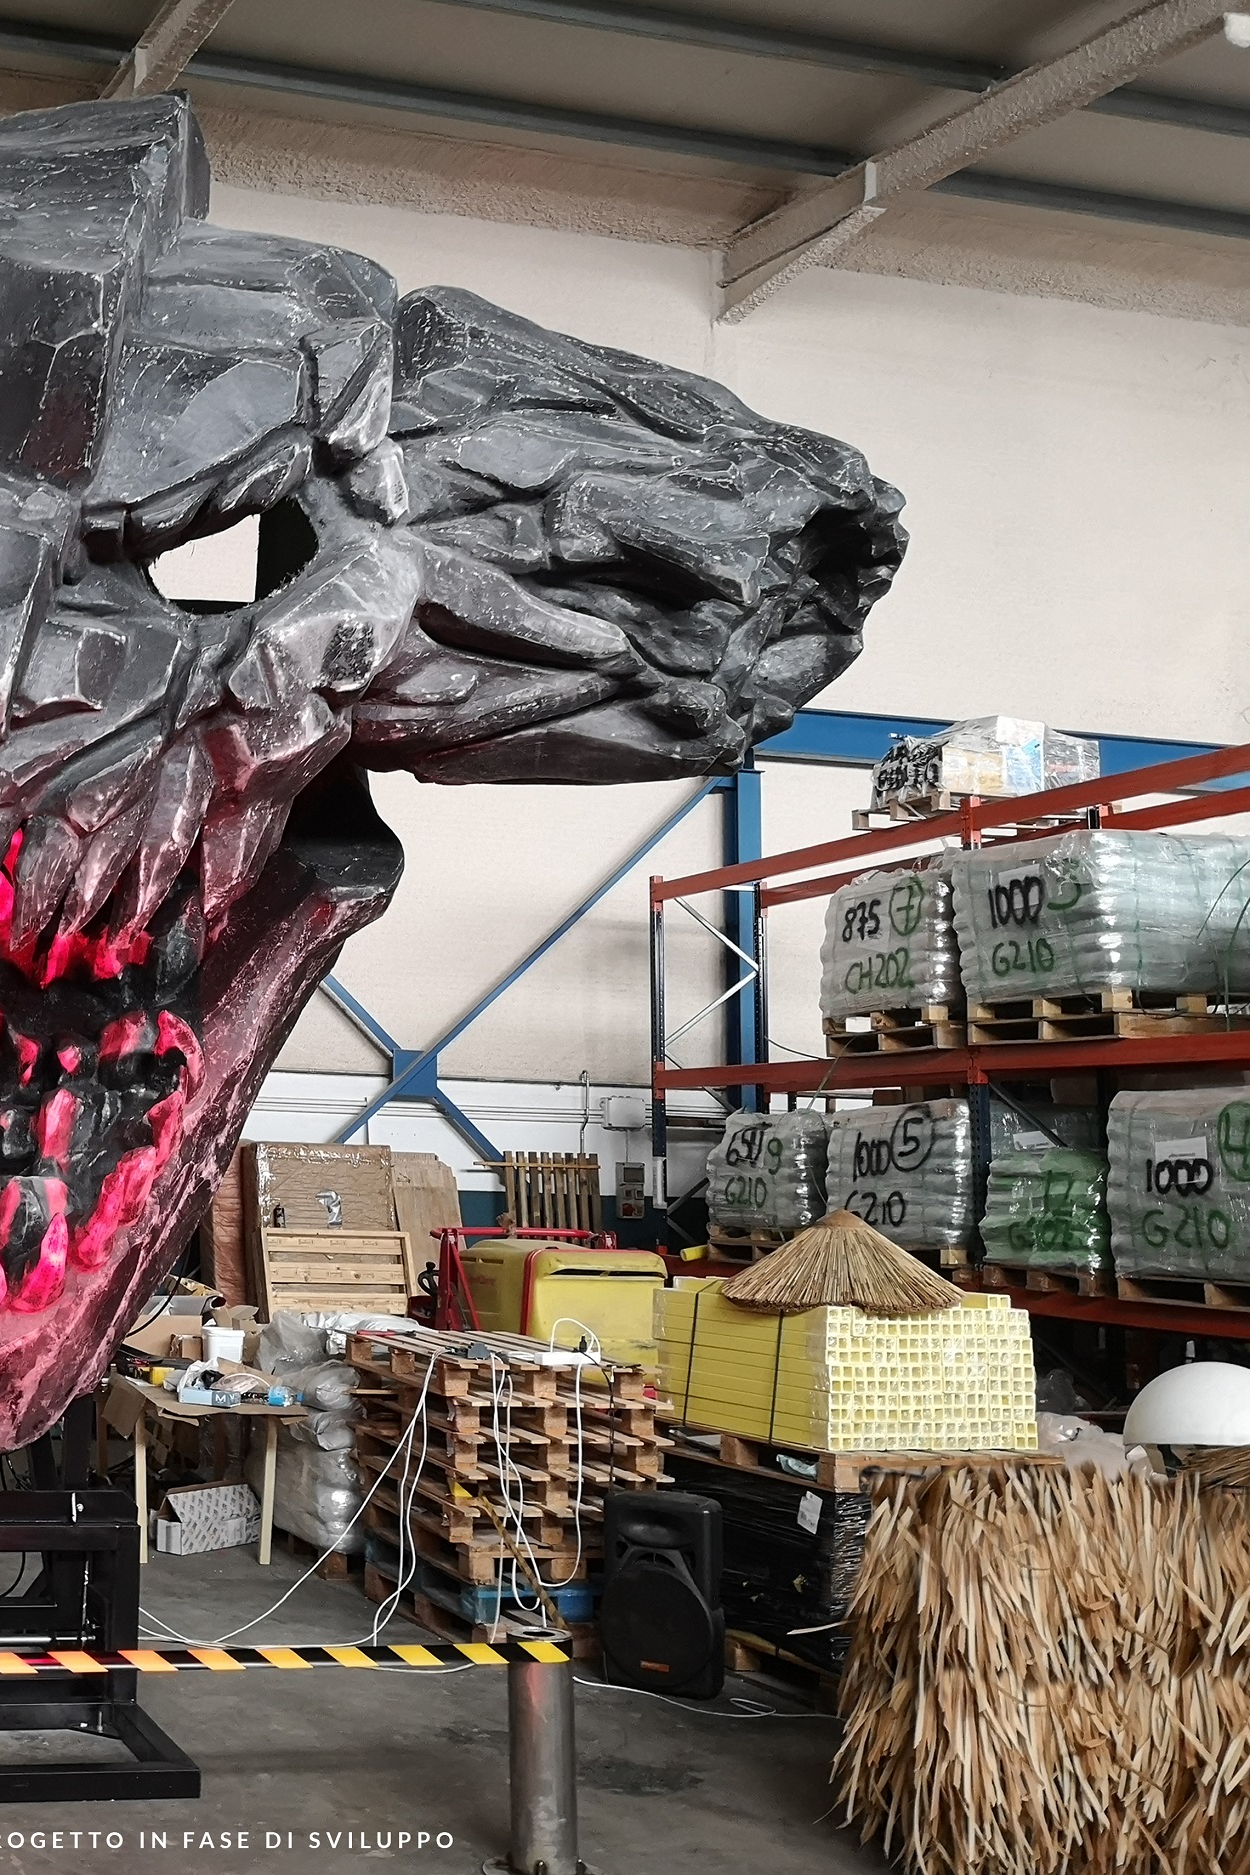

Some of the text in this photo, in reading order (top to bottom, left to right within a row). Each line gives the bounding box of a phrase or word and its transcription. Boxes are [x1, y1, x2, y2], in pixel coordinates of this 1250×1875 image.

[841, 899, 881, 942] 875
[988, 876, 1044, 928] 1000
[844, 947, 914, 994] CH202
[992, 938, 1054, 977] G210
[853, 1132, 891, 1182] 1000
[1146, 1158, 1214, 1196] 1000
[725, 1176, 767, 1209] G210
[1143, 1203, 1231, 1249] G210
